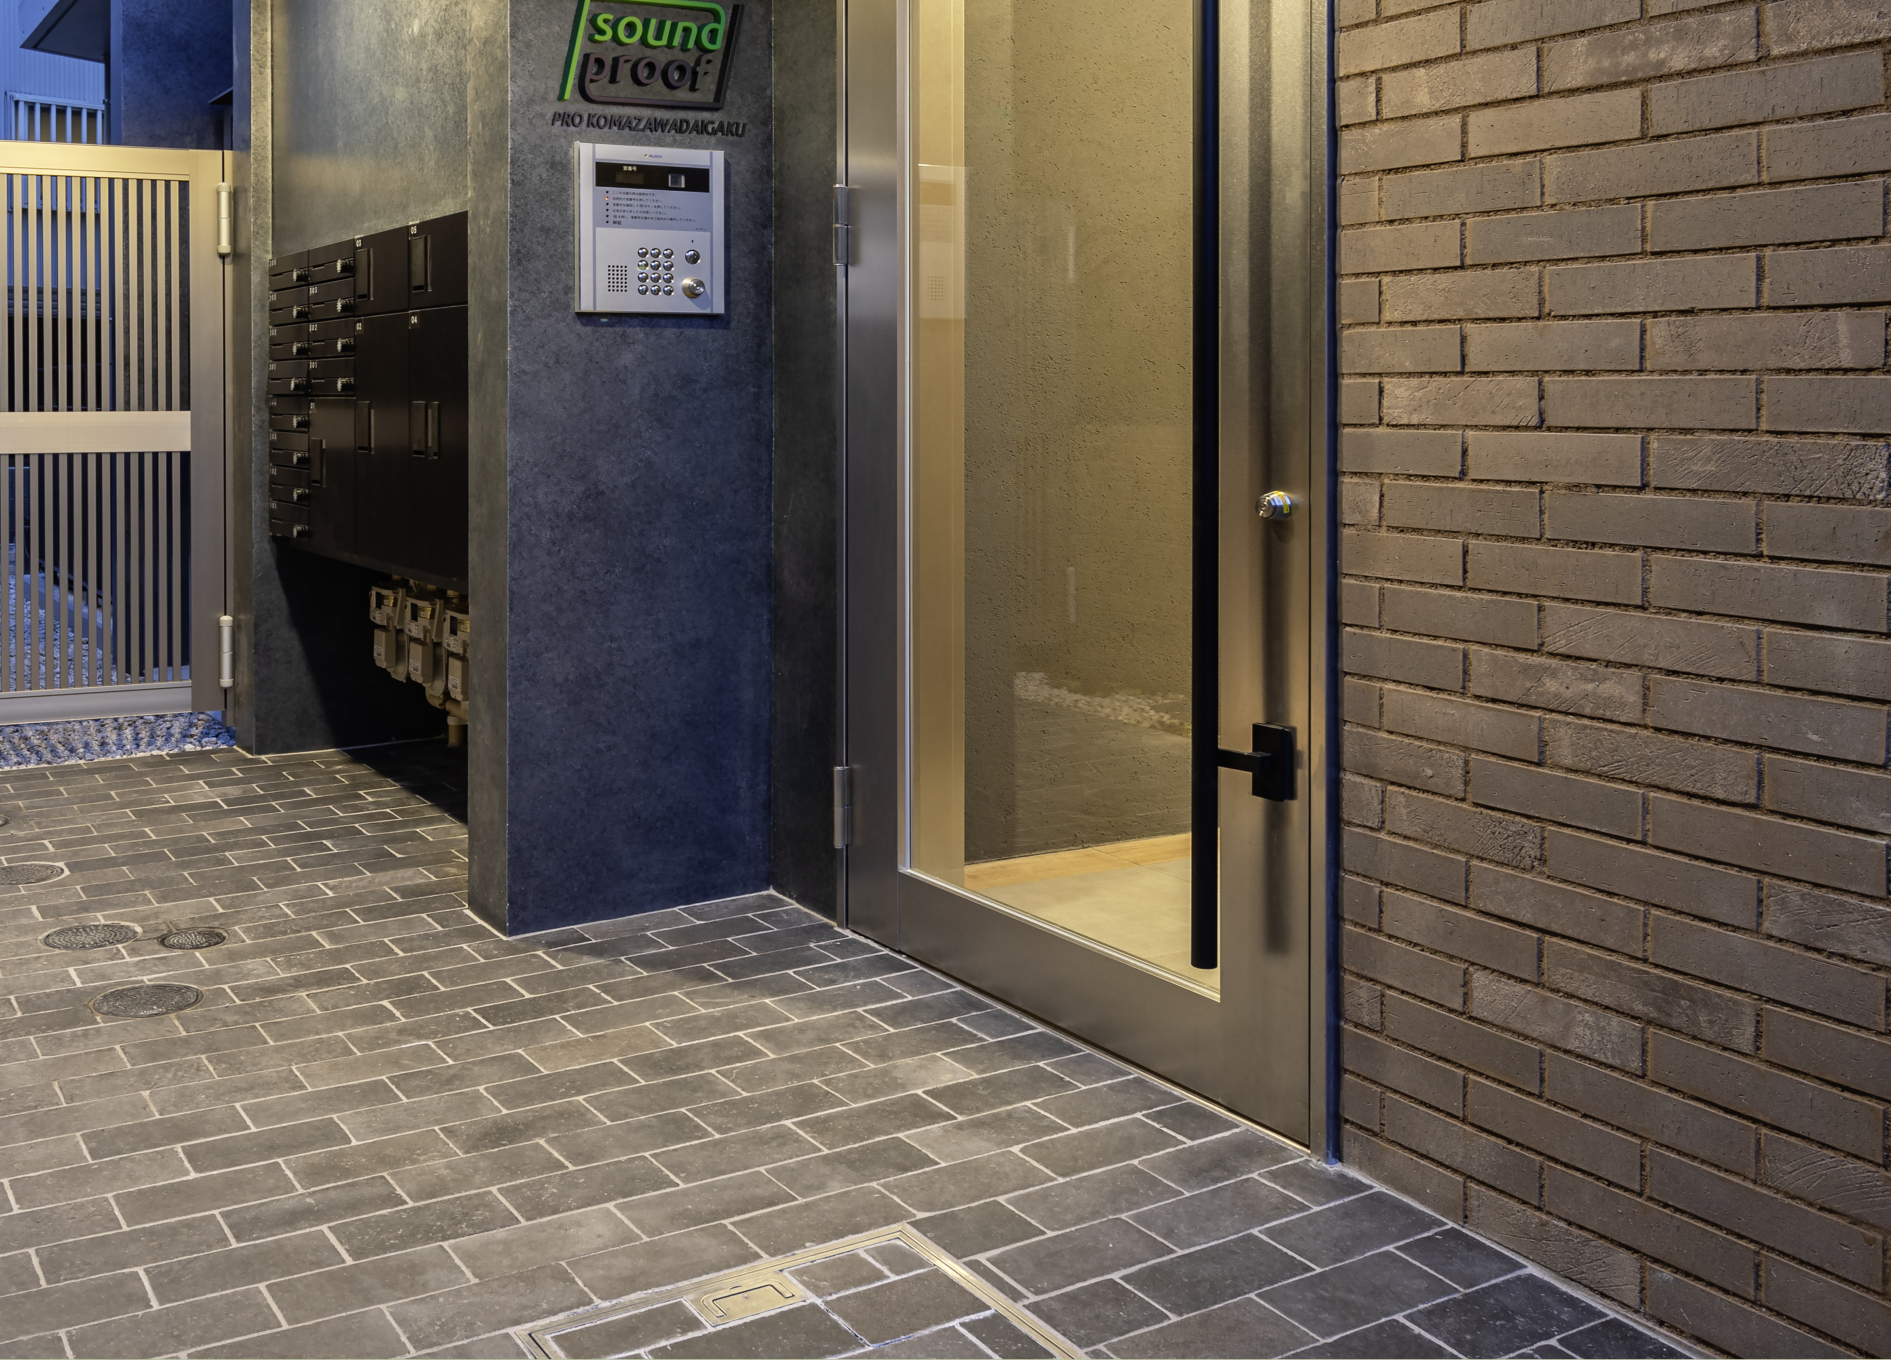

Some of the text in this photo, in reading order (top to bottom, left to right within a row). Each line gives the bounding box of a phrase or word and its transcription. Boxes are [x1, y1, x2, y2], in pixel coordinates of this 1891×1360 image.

[587, 3, 726, 52] sound
[551, 111, 746, 138] PRO KOMAZAWADAIGAKU
